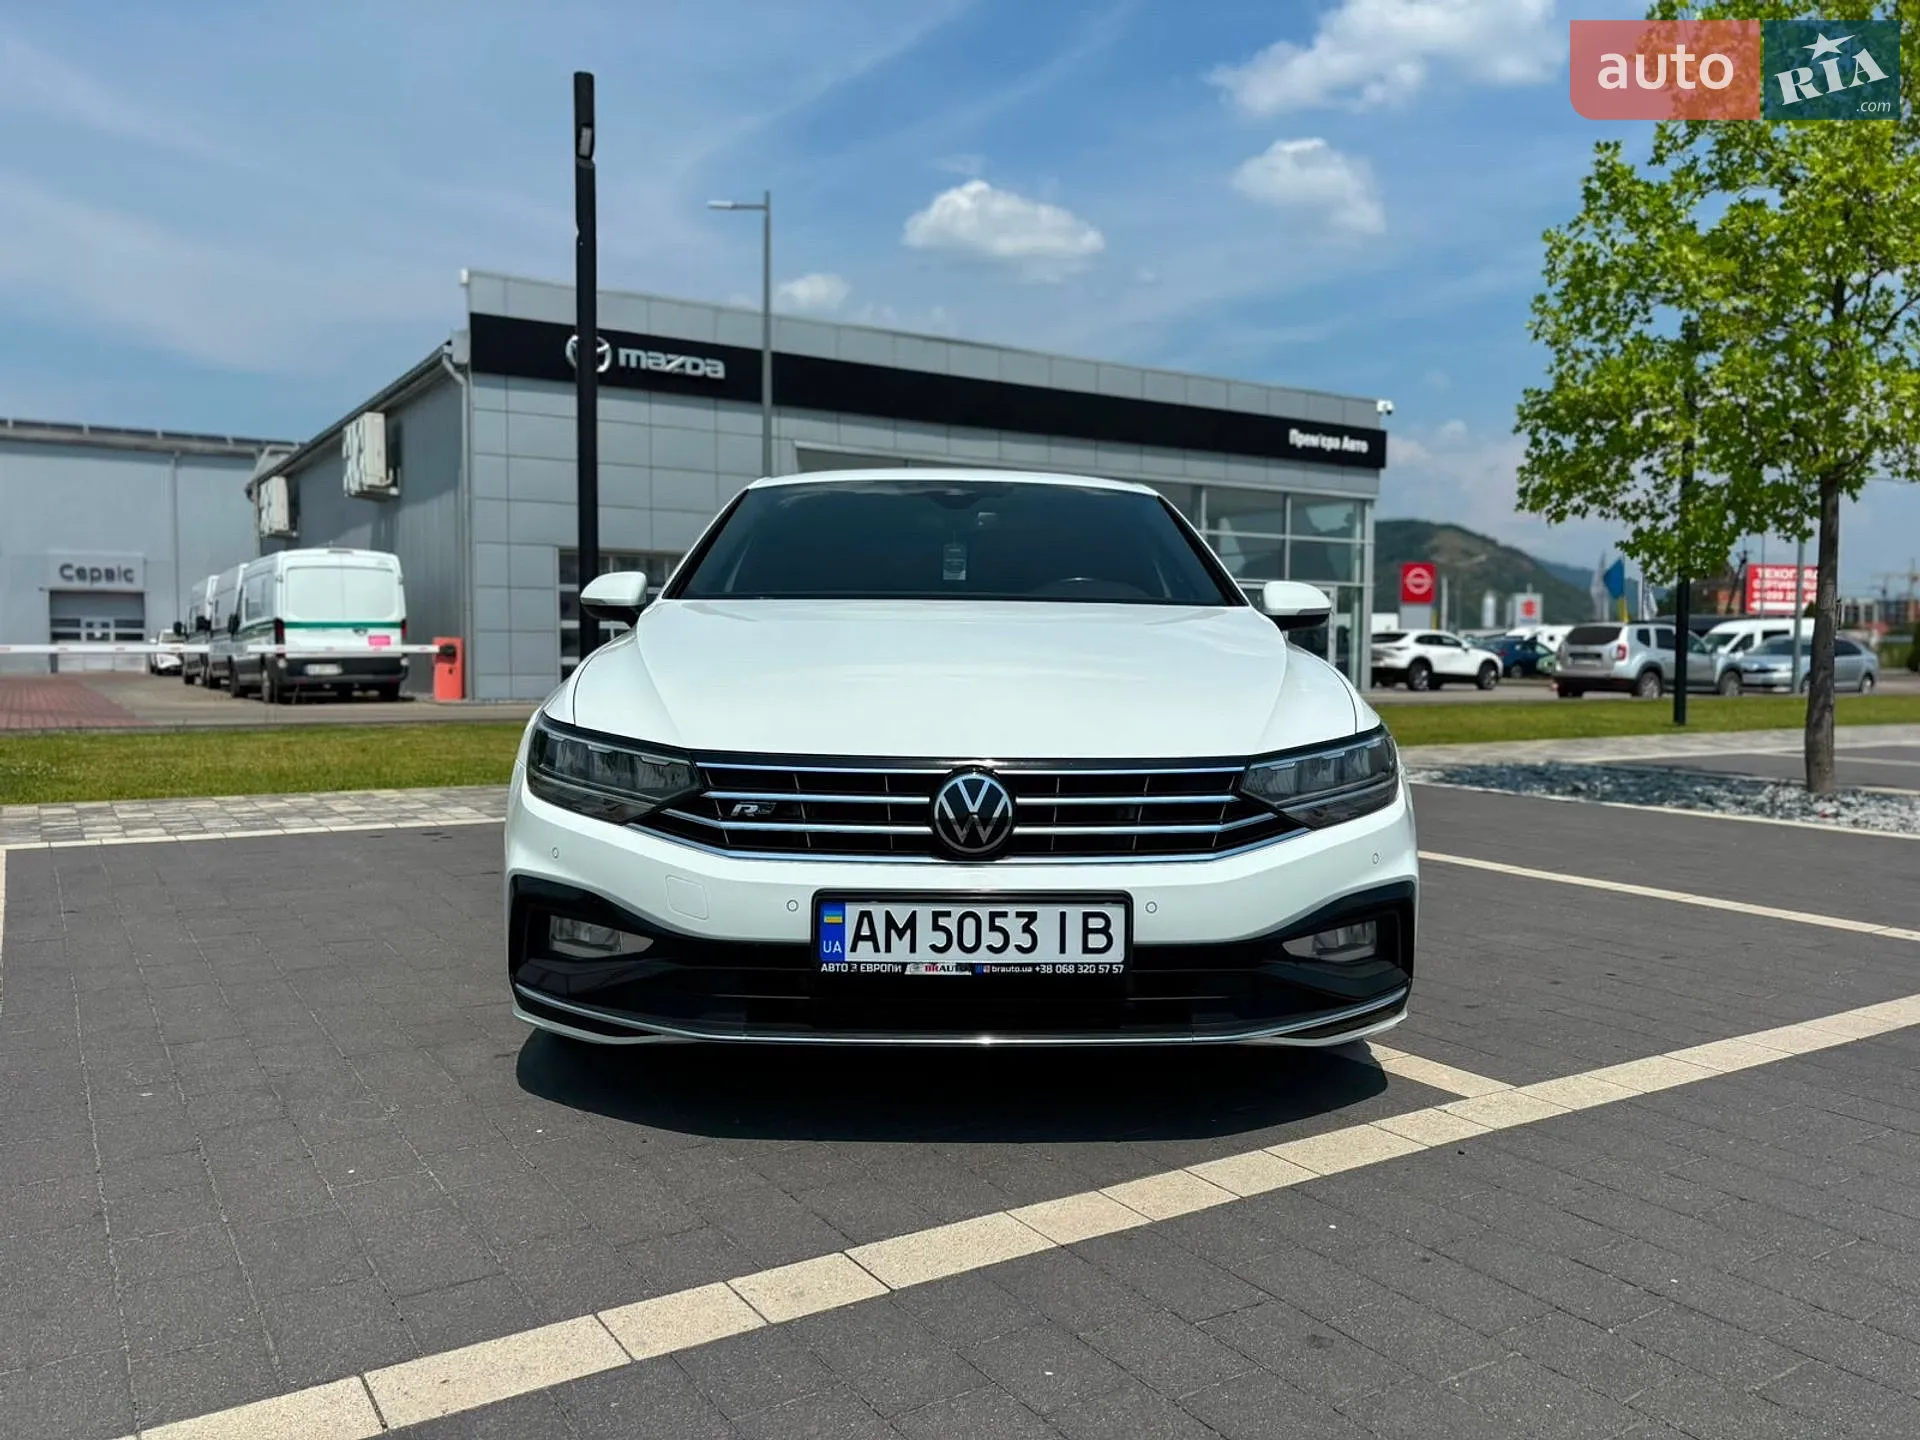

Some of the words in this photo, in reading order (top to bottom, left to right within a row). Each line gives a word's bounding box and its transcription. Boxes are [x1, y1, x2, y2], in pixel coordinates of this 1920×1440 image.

[850, 910, 917, 954] AM
[929, 910, 1038, 955] 5053
[823, 941, 842, 954] UA
